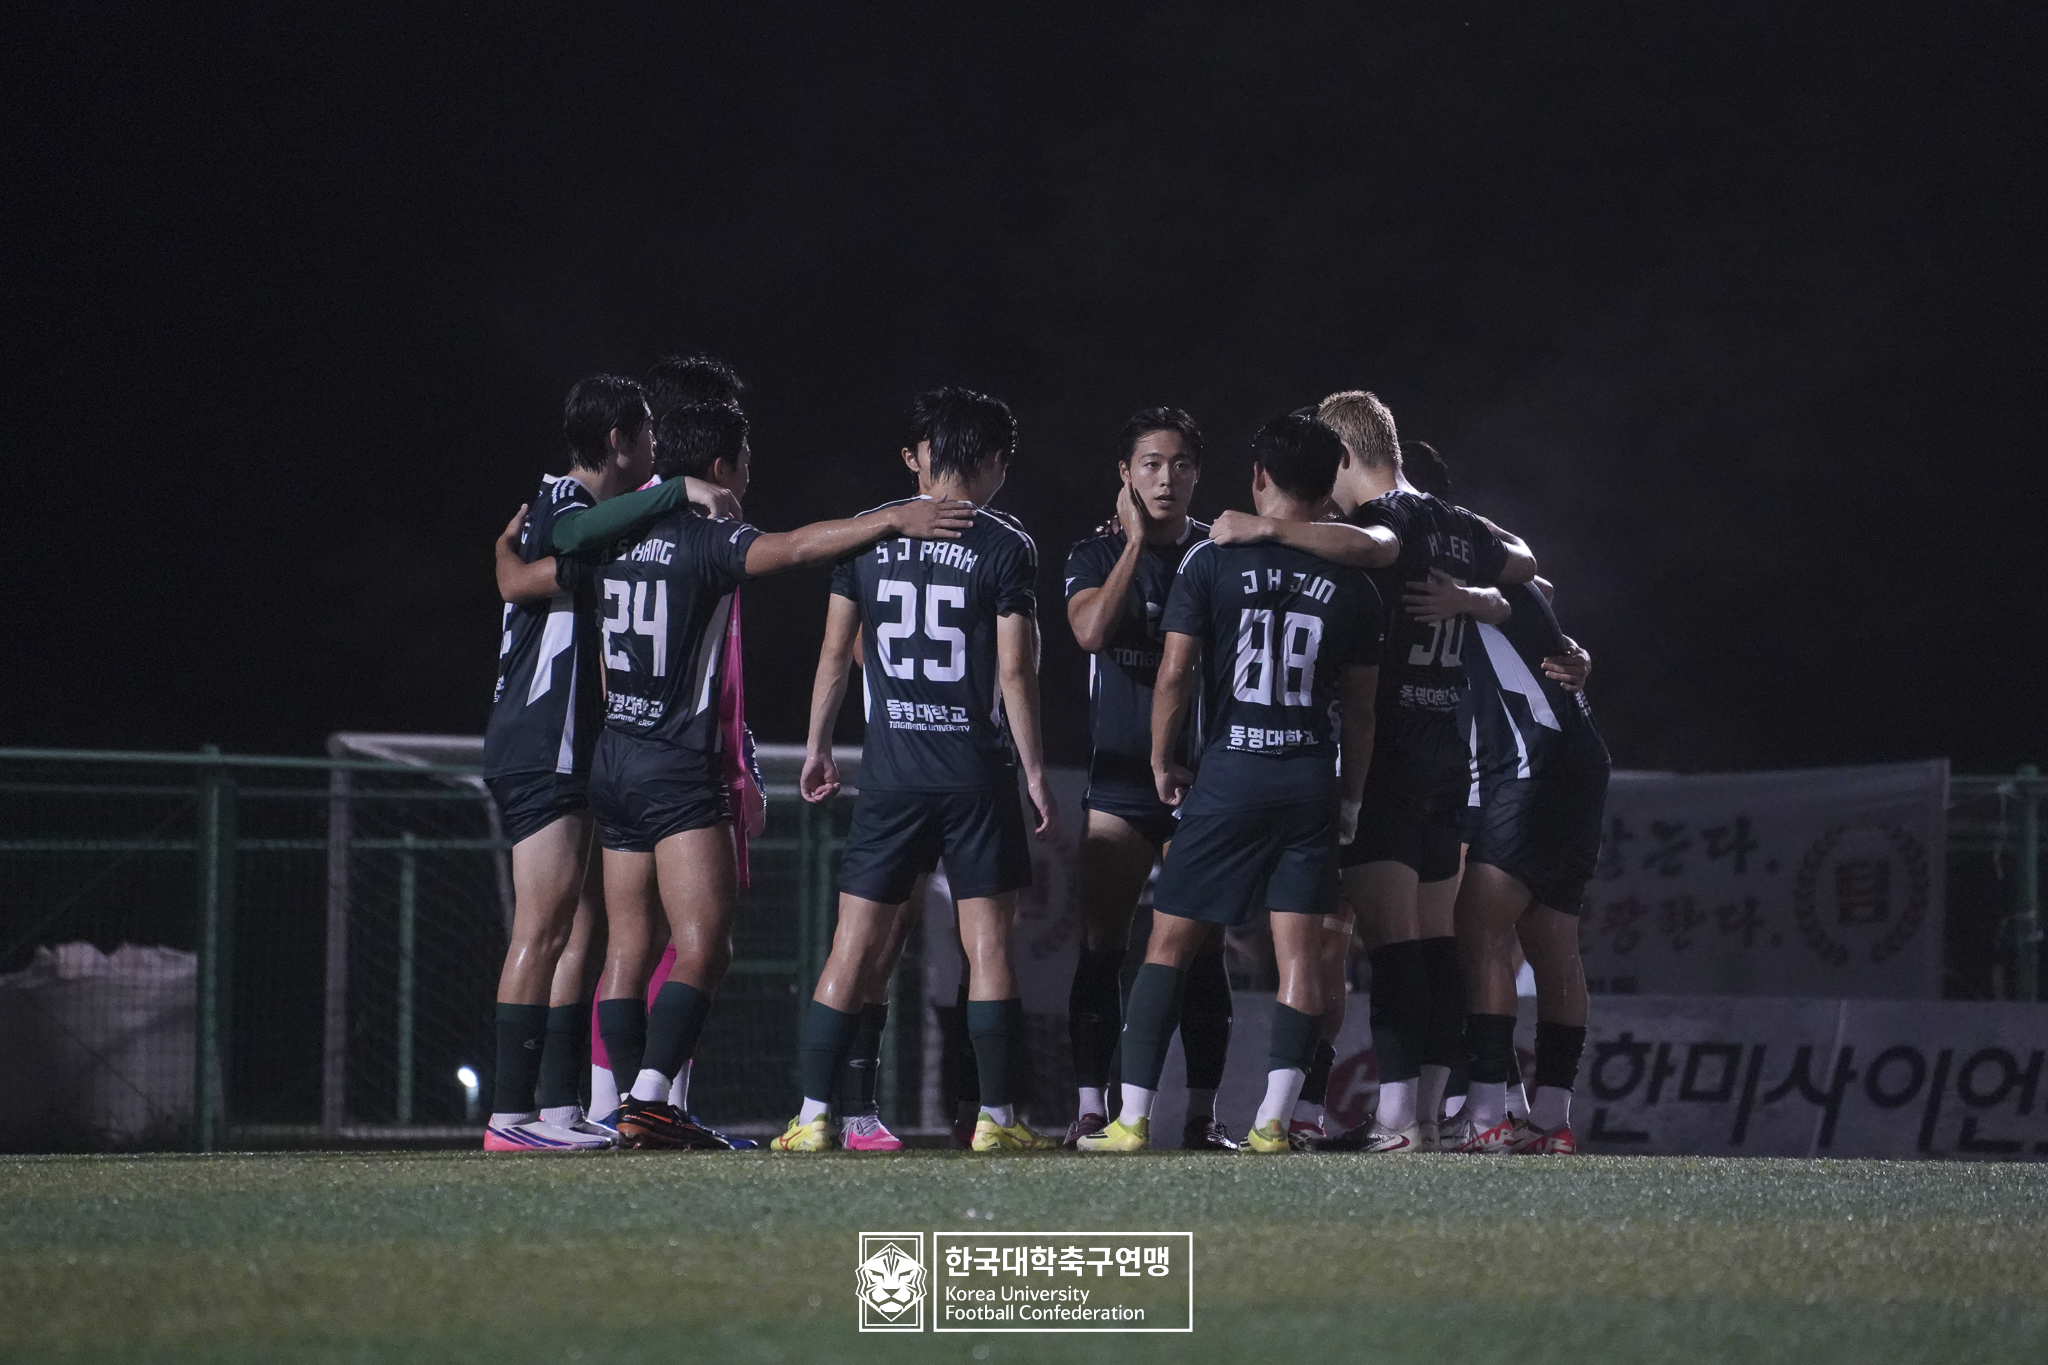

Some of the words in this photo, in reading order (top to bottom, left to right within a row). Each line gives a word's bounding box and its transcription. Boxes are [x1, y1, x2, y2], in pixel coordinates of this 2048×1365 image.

[875, 541, 890, 564] S
[897, 537, 911, 561] J
[1241, 569, 1259, 595] J
[1266, 568, 1282, 591] H
[601, 578, 669, 678] 24
[876, 578, 967, 683] 25
[1232, 607, 1325, 707] 88
[886, 699, 969, 723] 동명대학교
[1229, 725, 1320, 749] 동명대학교
[1587, 1032, 2048, 1156] 한미사이언
